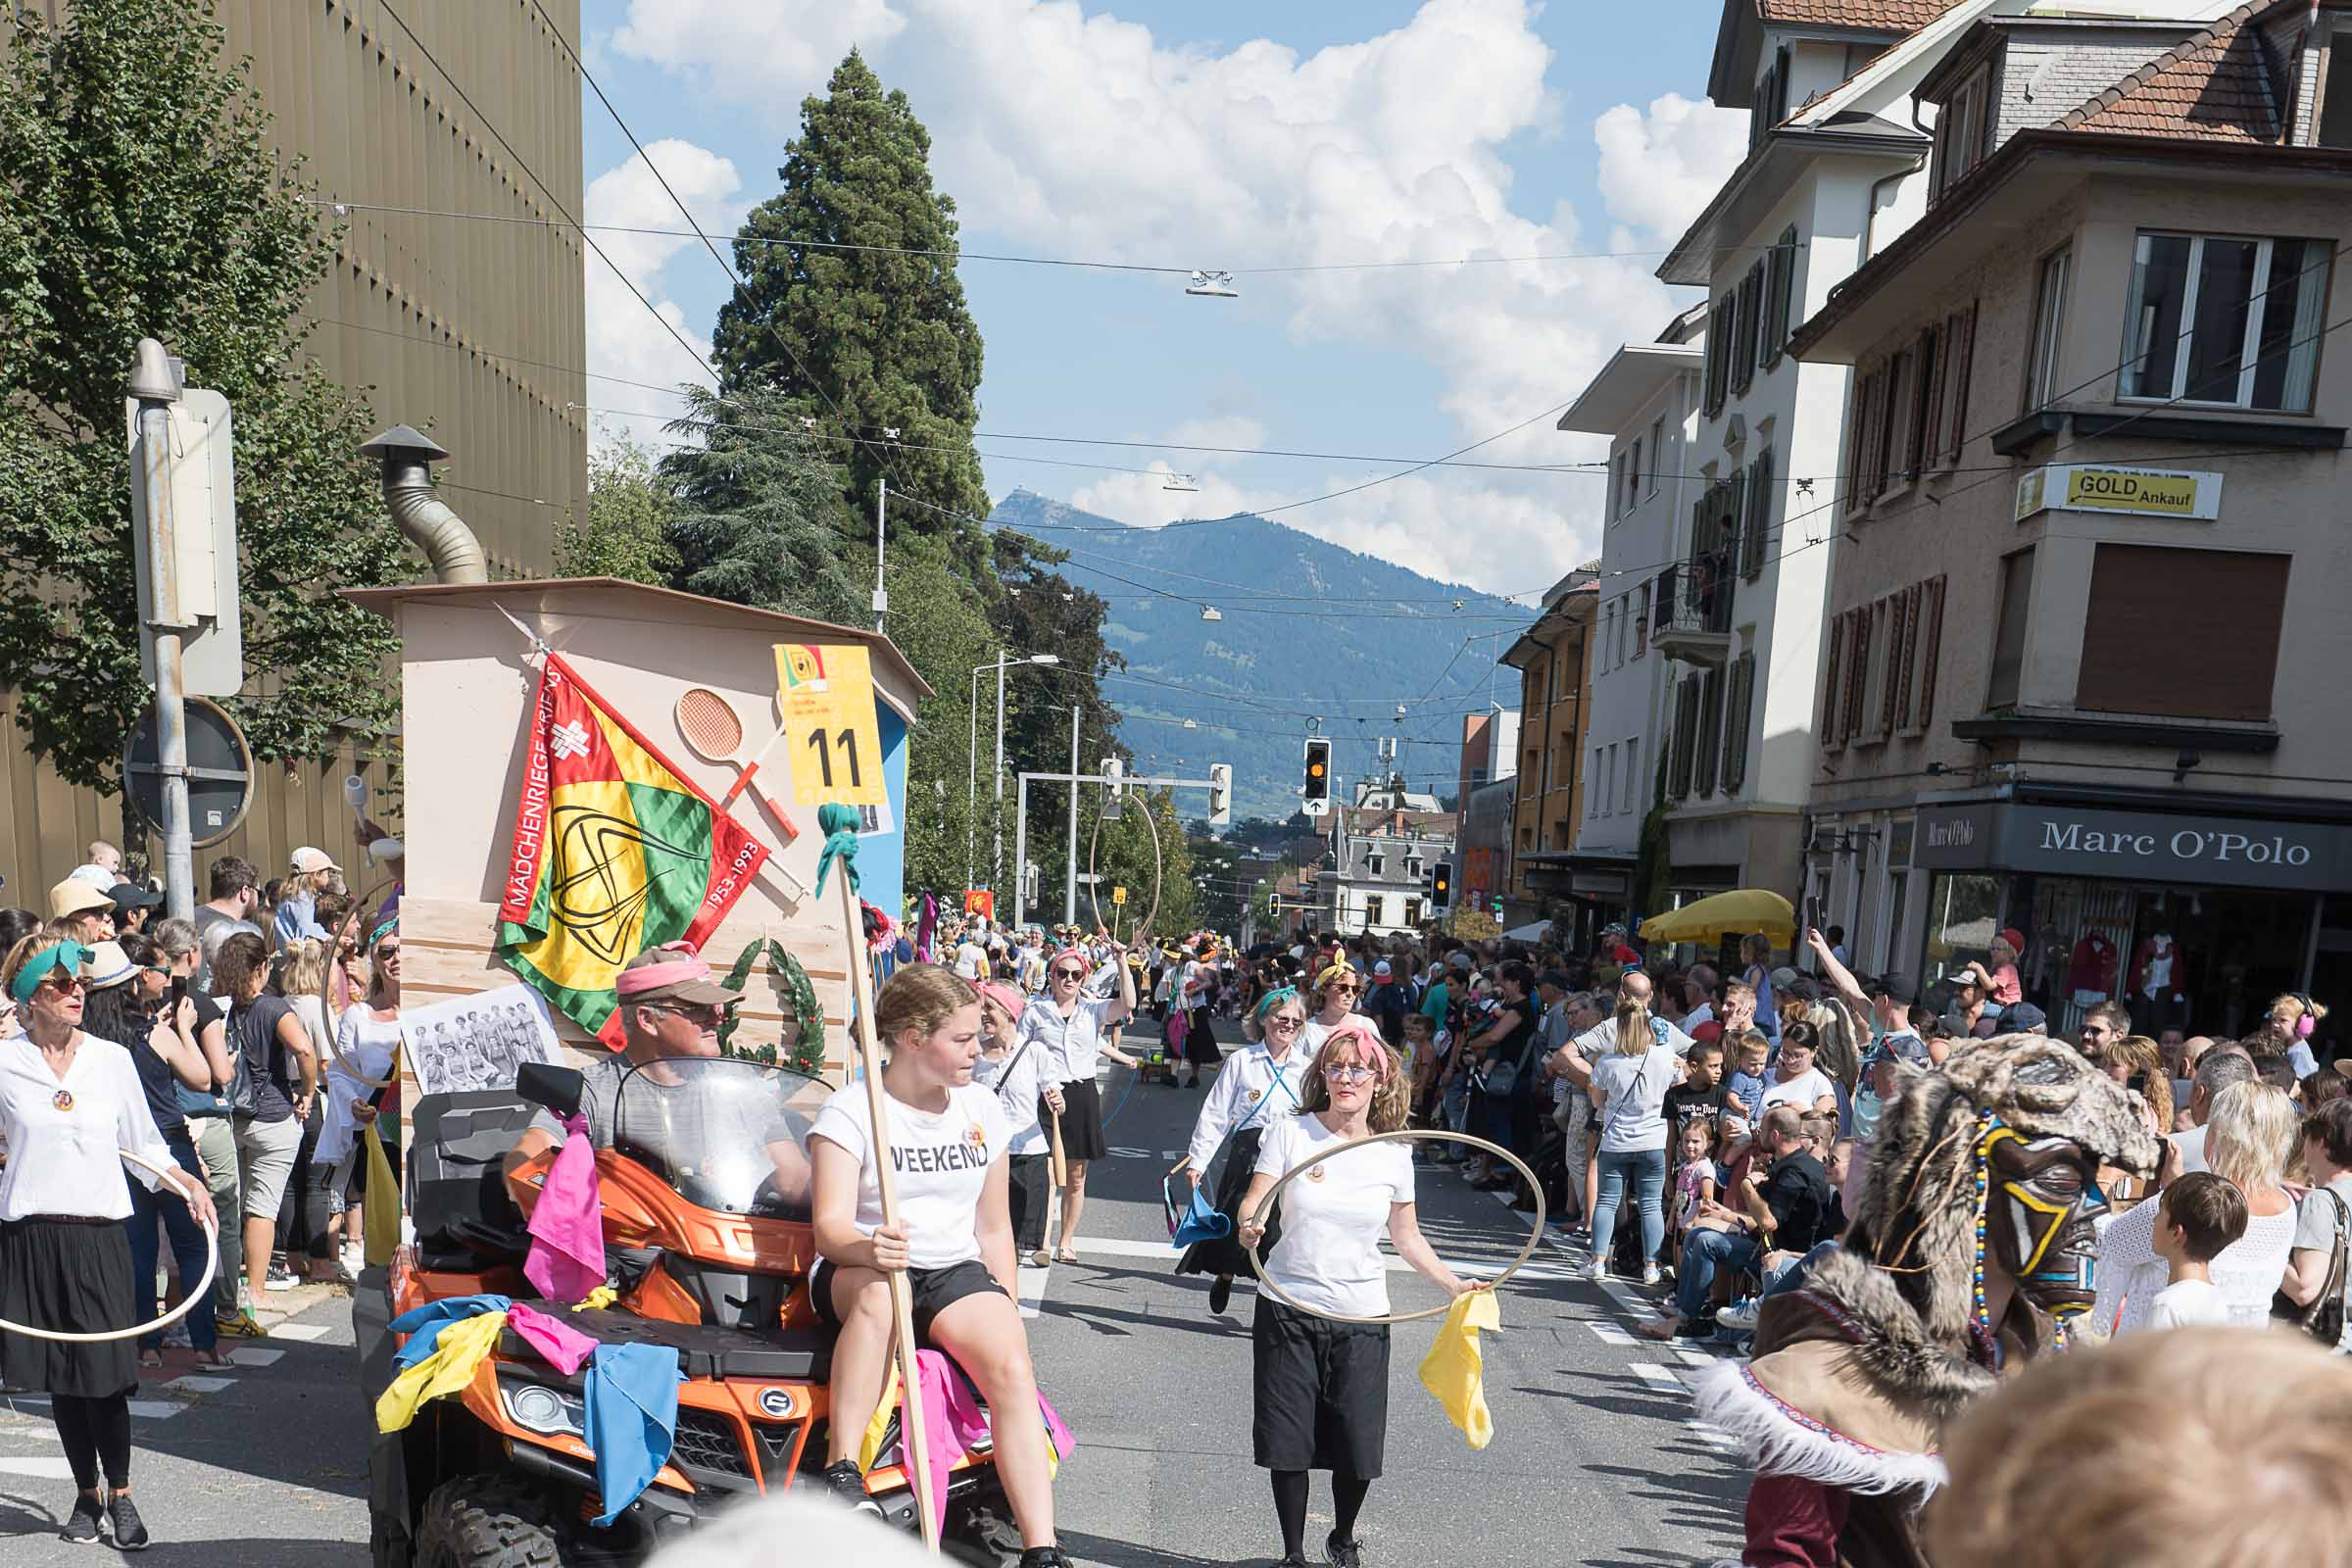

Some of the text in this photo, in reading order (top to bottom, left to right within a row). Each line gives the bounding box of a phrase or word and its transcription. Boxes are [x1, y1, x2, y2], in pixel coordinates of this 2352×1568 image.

[2080, 475, 2191, 507] GOLD Ankauf
[808, 728, 861, 788] 11
[510, 740, 550, 907] MÄDCHENRIEGE
[2039, 821, 2311, 865] Marc O'Polo
[707, 841, 760, 909] 1953-1993
